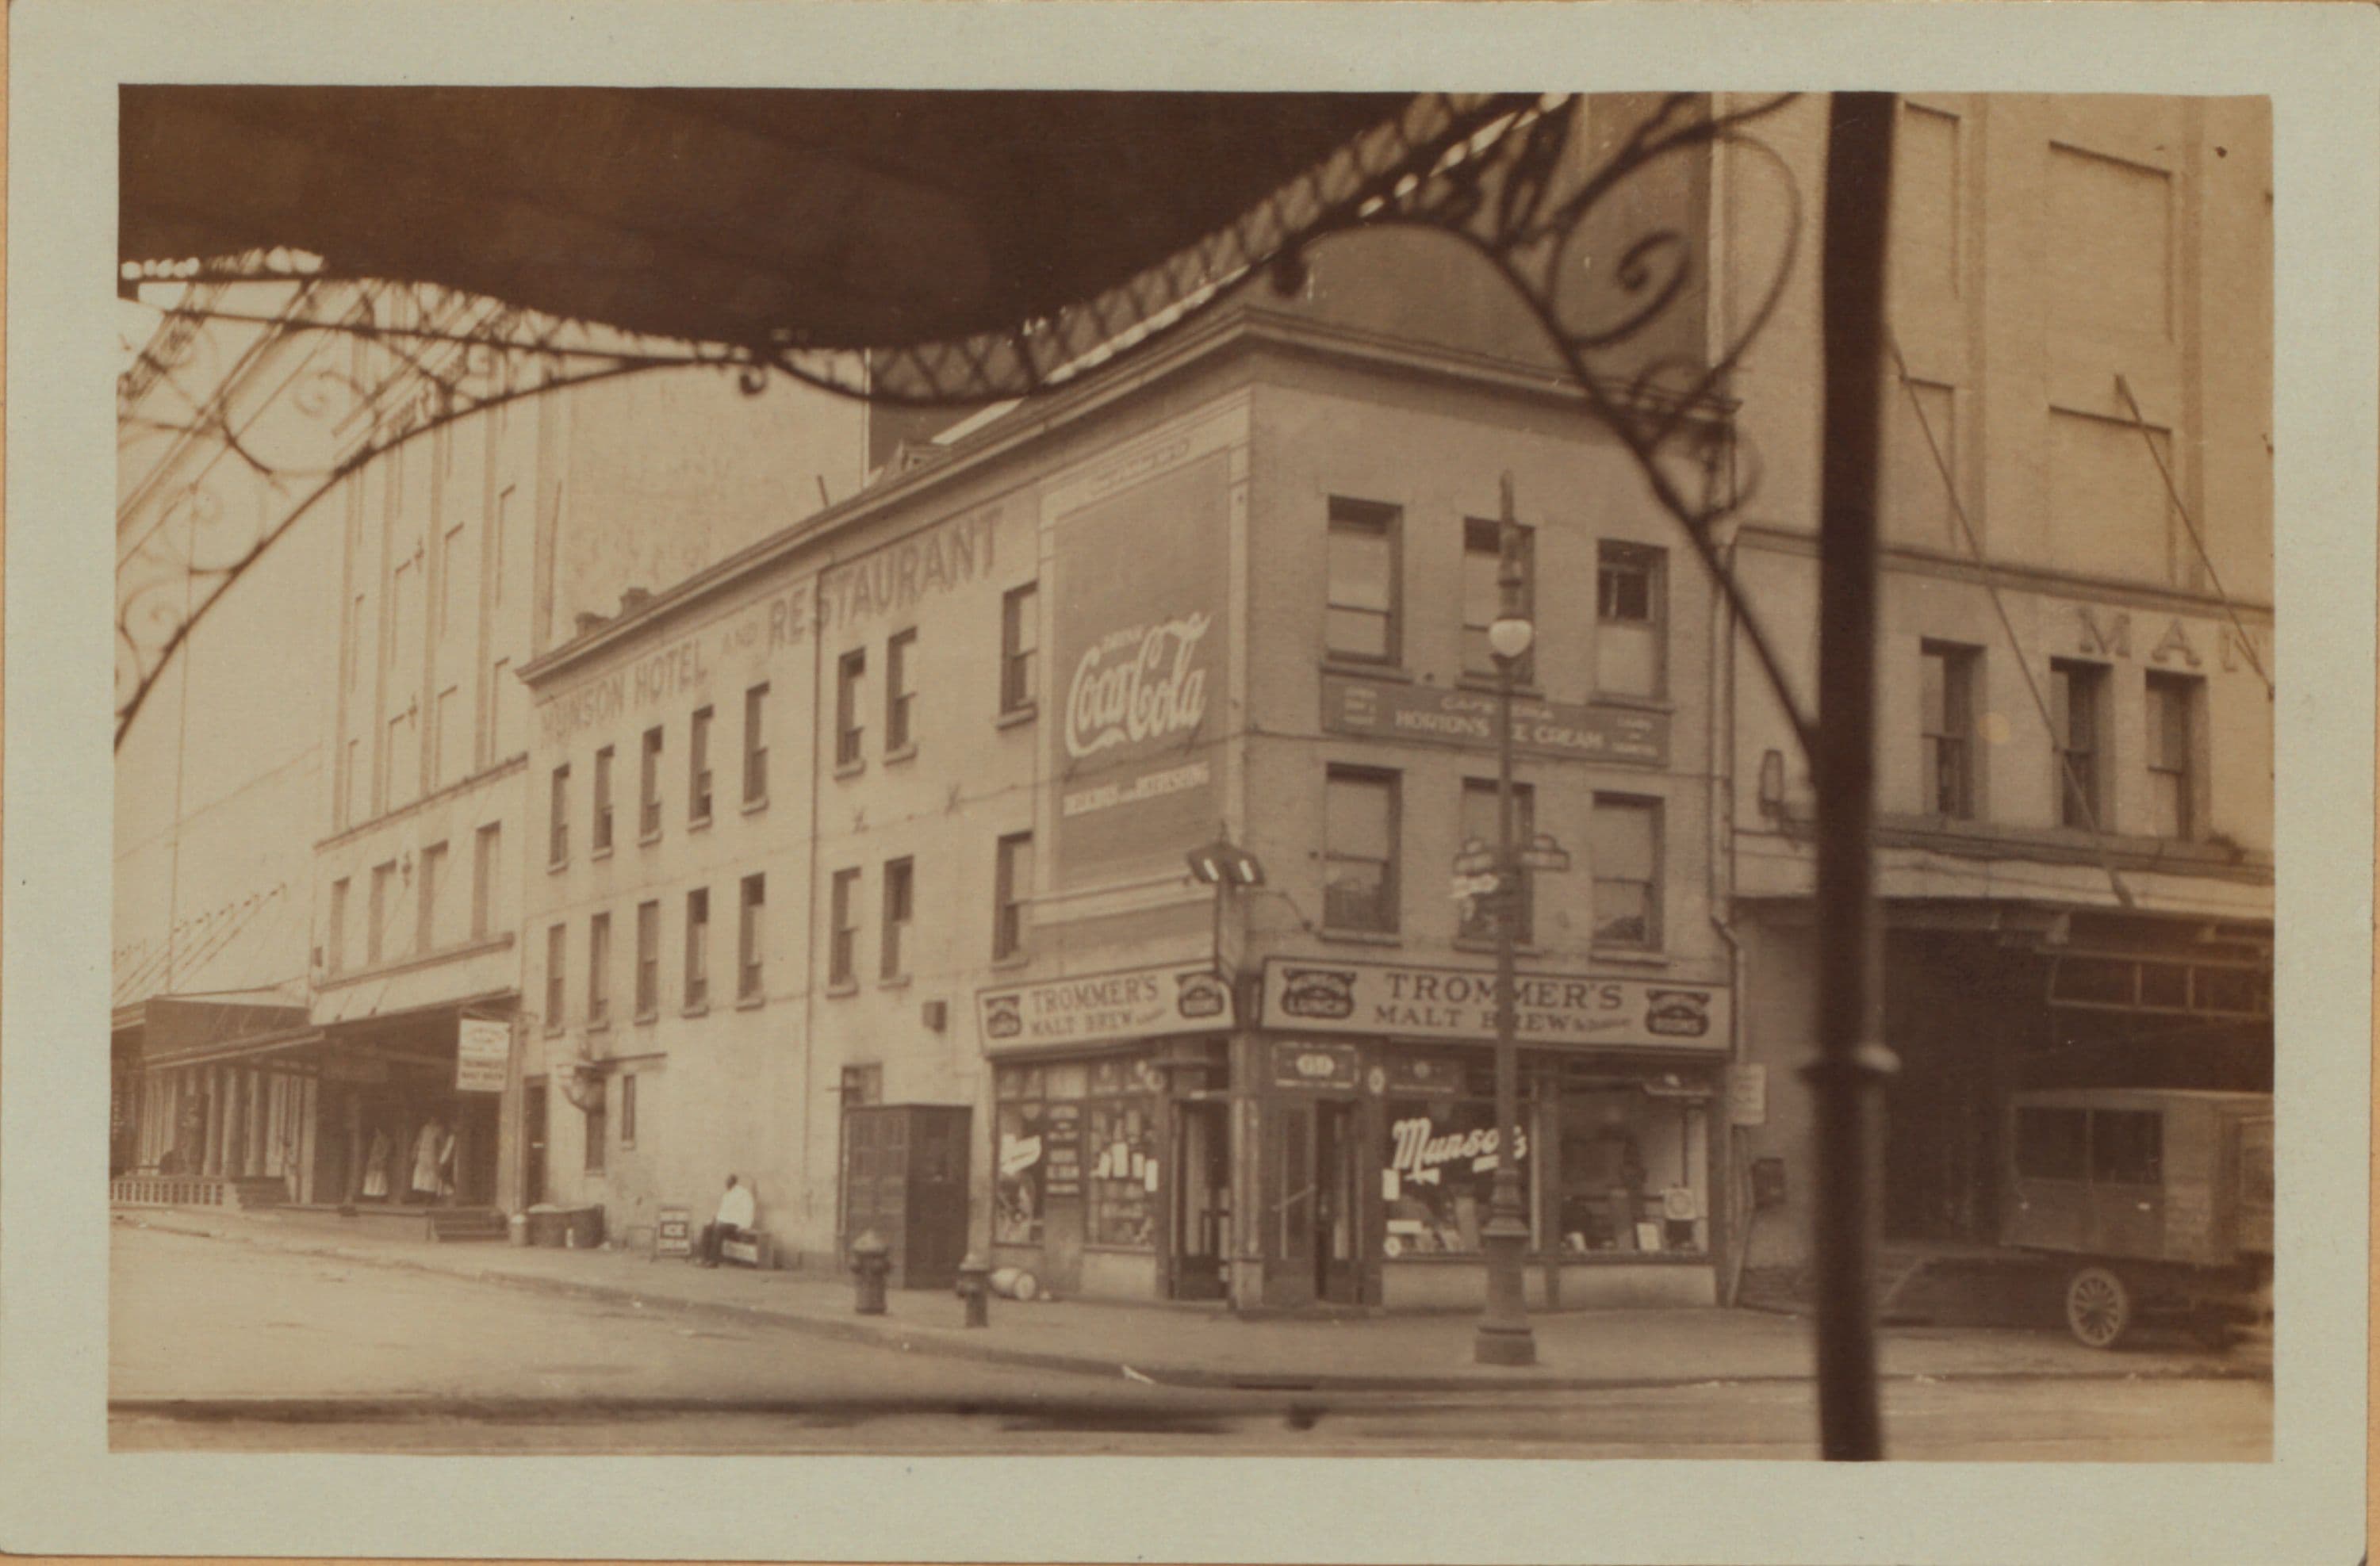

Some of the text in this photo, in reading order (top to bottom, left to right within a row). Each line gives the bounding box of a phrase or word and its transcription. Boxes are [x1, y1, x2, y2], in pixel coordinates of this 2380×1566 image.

[635, 638, 707, 707] HOTEL
[768, 507, 1004, 653] RESTAURANT
[1032, 975, 1158, 1014] TROMMER'S
[1031, 1015, 1075, 1036] MALT
[1374, 1004, 1463, 1028] MALT
[1393, 1117, 1527, 1174] Munso's
